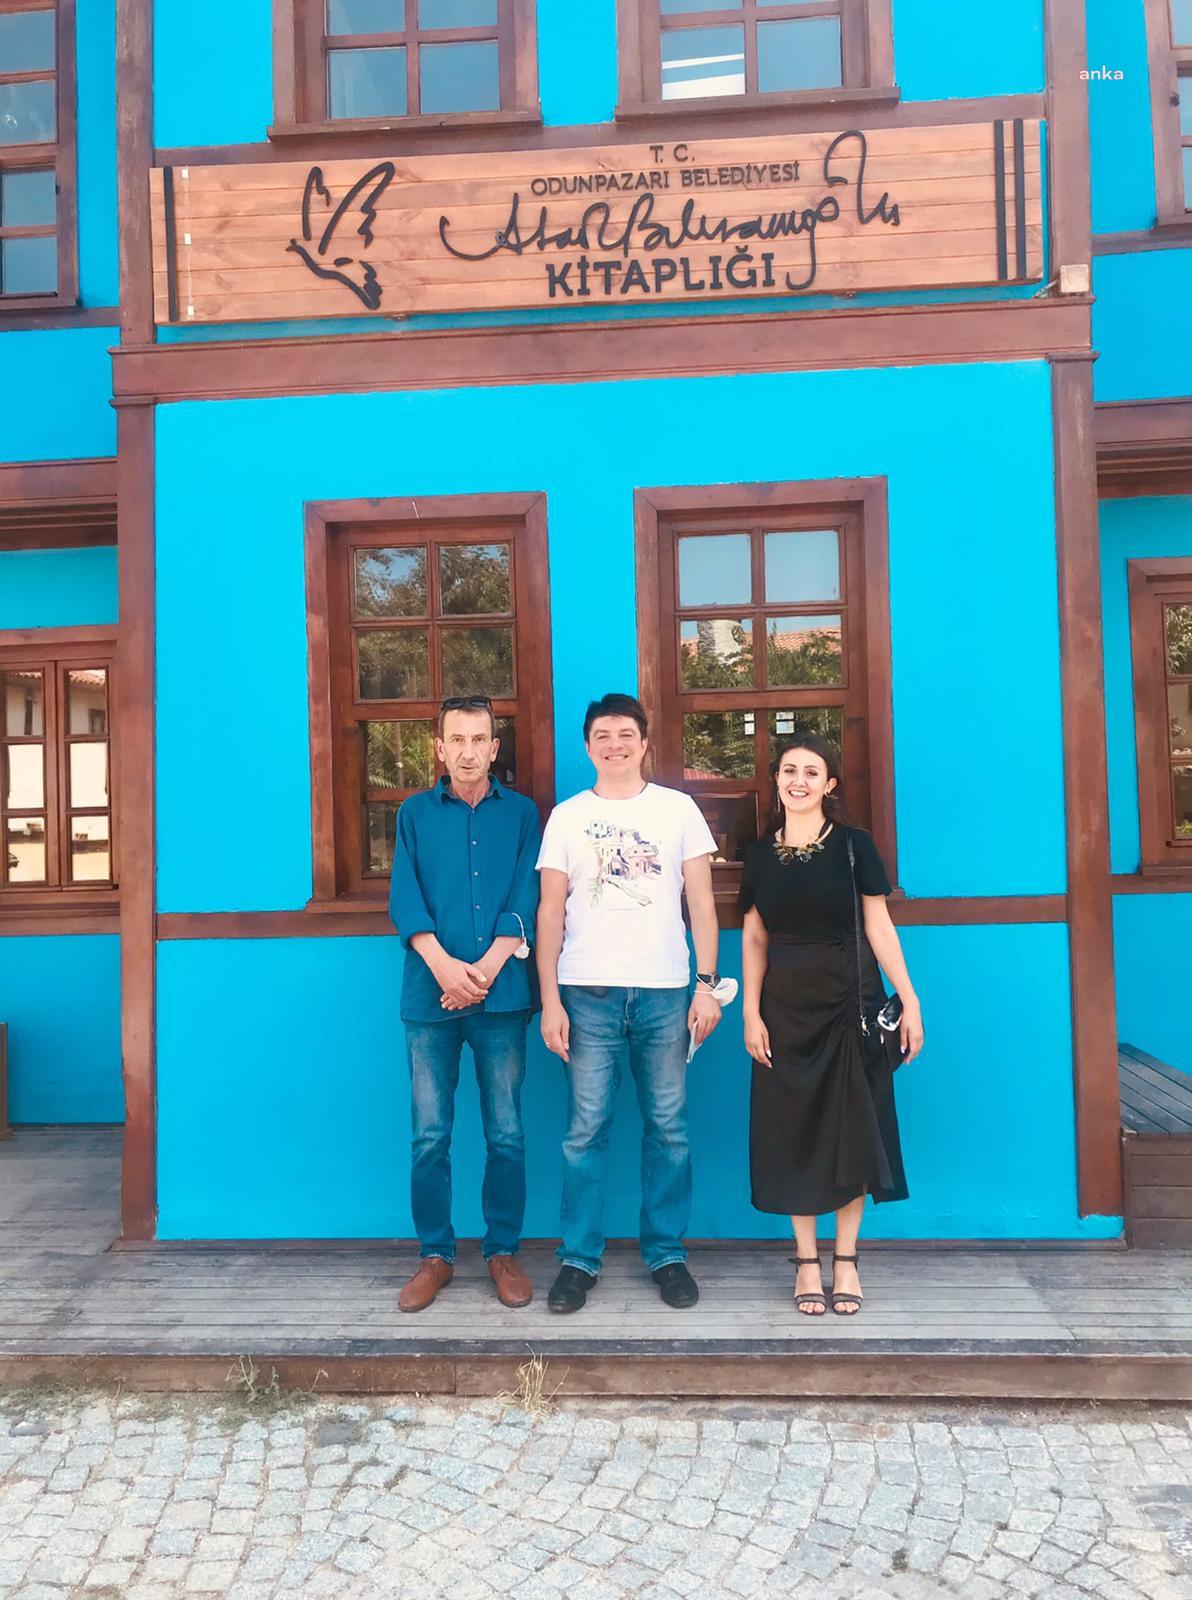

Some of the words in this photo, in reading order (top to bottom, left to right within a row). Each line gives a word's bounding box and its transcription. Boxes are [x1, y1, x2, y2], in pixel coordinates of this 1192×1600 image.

[649, 145, 664, 163] T.
[673, 143, 695, 162] C.
[531, 170, 669, 196] ODUNPAZARI
[681, 160, 800, 188] BELEDİYESİ
[545, 245, 775, 298] KİTAPLIĞI
